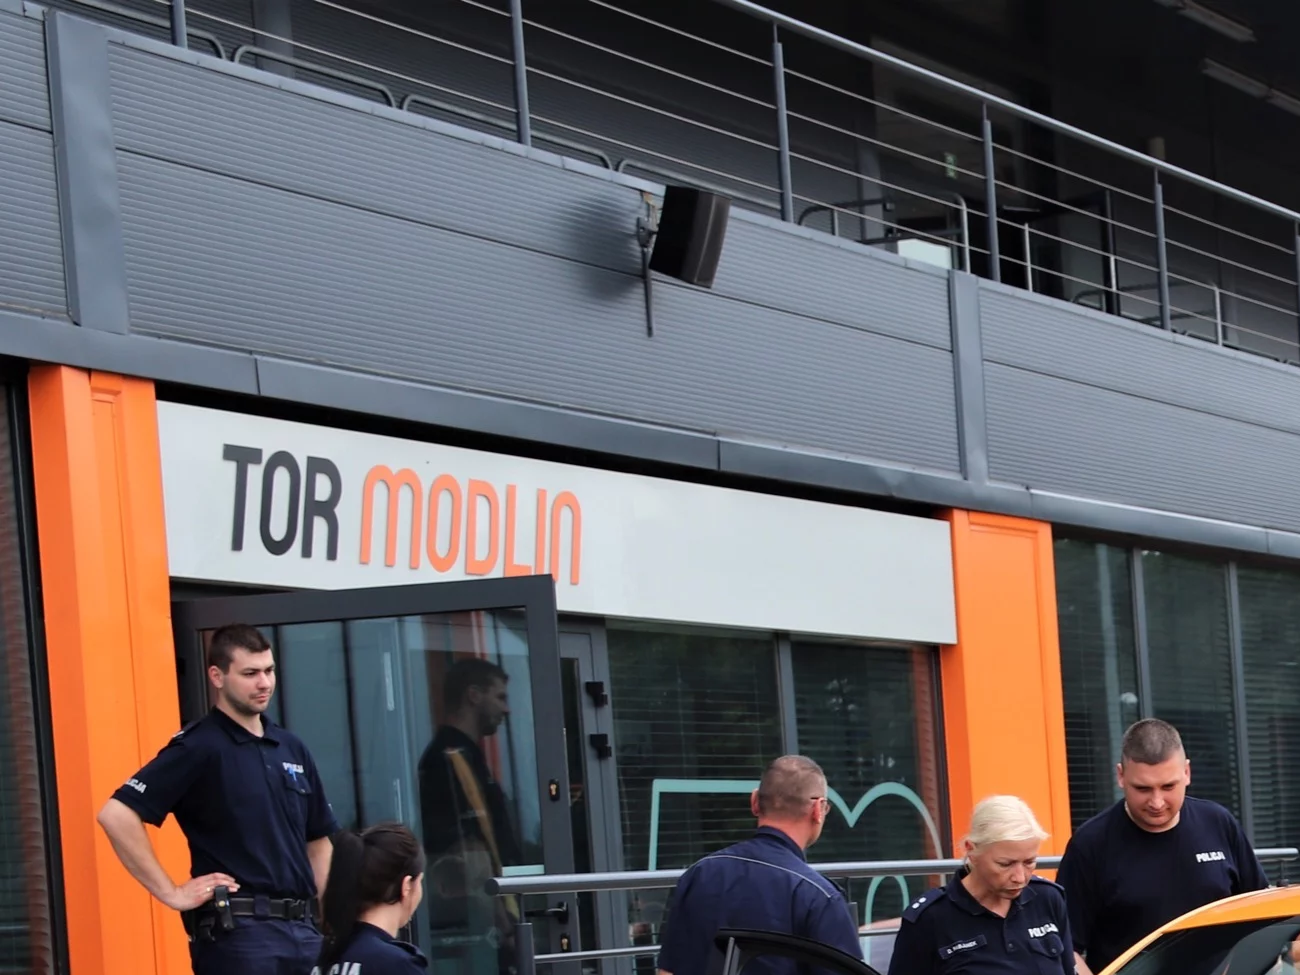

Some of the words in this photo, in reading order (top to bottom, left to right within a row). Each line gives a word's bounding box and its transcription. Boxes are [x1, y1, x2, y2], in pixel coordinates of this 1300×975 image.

[223, 444, 342, 562] TOR
[359, 464, 582, 586] MODLIN
[1195, 851, 1226, 863] POLICJA
